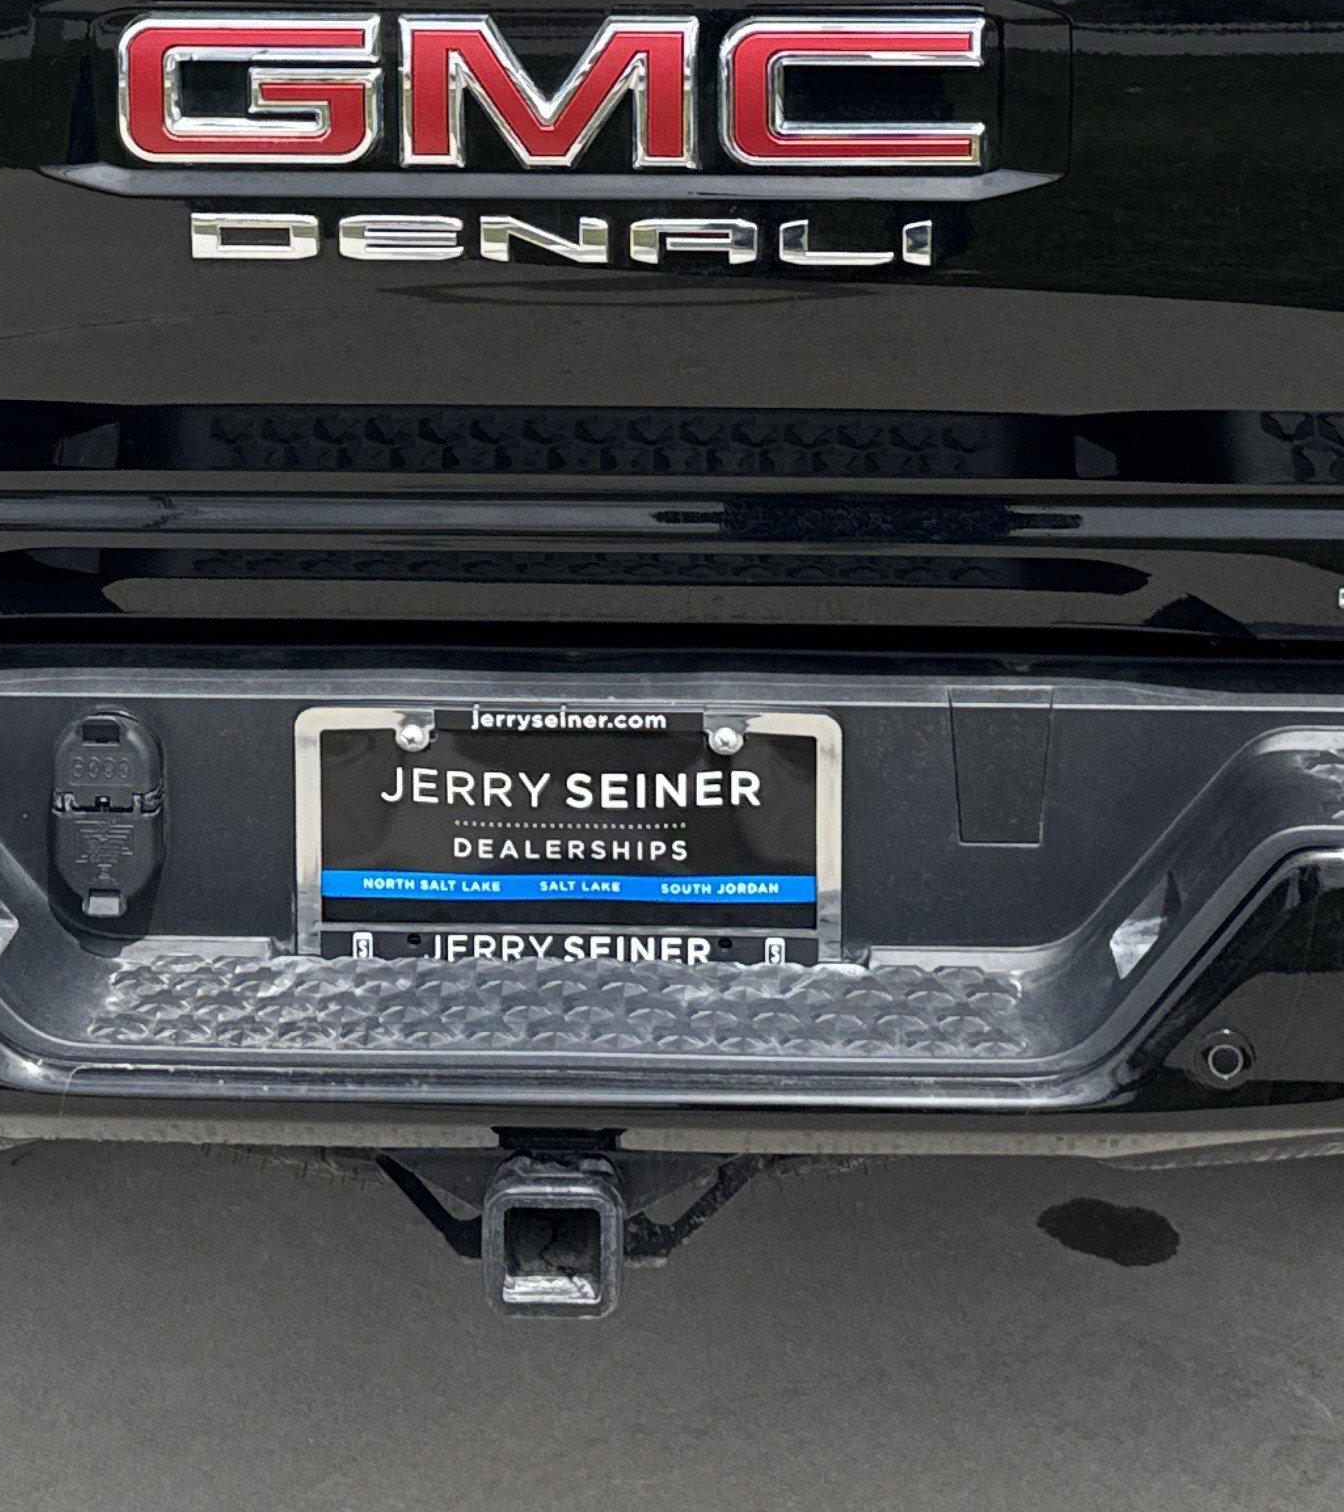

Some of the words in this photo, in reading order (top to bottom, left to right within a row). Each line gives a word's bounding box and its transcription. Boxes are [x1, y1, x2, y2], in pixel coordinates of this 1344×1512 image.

[118, 14, 986, 168] GMC
[190, 212, 933, 267] DENALI
[471, 703, 667, 731] jerryseiner.com
[380, 766, 551, 808] JERRY
[565, 770, 761, 809] SEINER
[453, 837, 689, 862] DEALERSHIPS
[363, 877, 415, 891] NORTH
[420, 878, 456, 891] SALT
[461, 880, 501, 892] LAKE
[539, 880, 576, 892] SALT
[581, 881, 621, 893] LAKE
[660, 882, 712, 895] SOUTH
[717, 882, 779, 894] JORDAN
[424, 935, 553, 961] JERRY
[564, 936, 712, 965] SEINER
